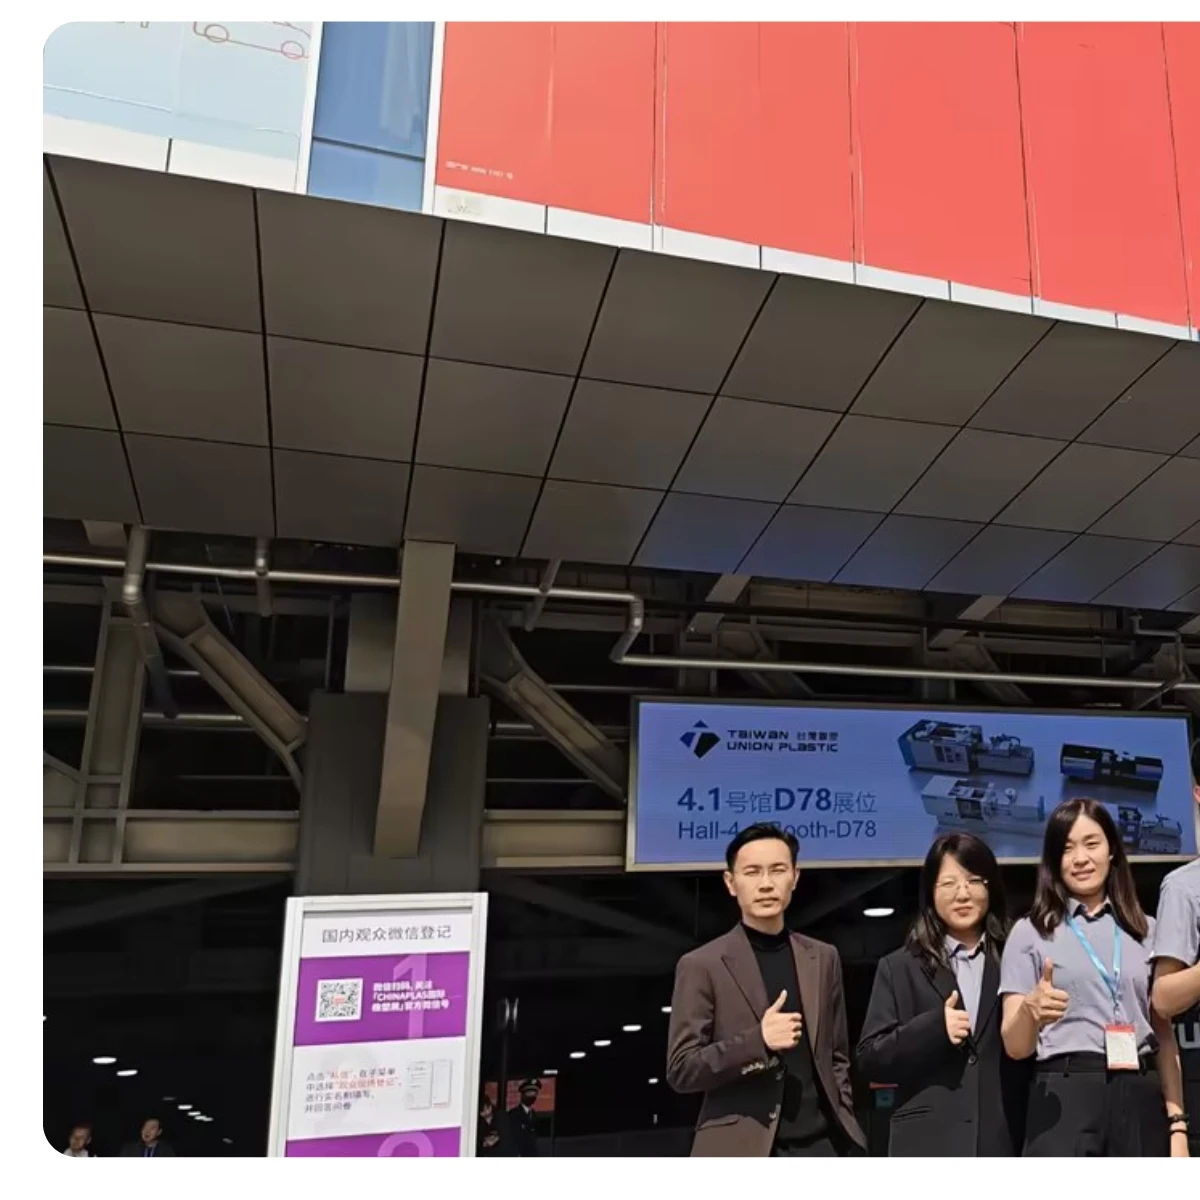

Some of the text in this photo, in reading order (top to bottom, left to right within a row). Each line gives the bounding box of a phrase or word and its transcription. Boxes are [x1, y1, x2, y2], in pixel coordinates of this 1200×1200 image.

[727, 742, 773, 752] UNION
[677, 787, 877, 814] 4.1号馆D78展位
[321, 925, 452, 943] 国内观众微信登记
